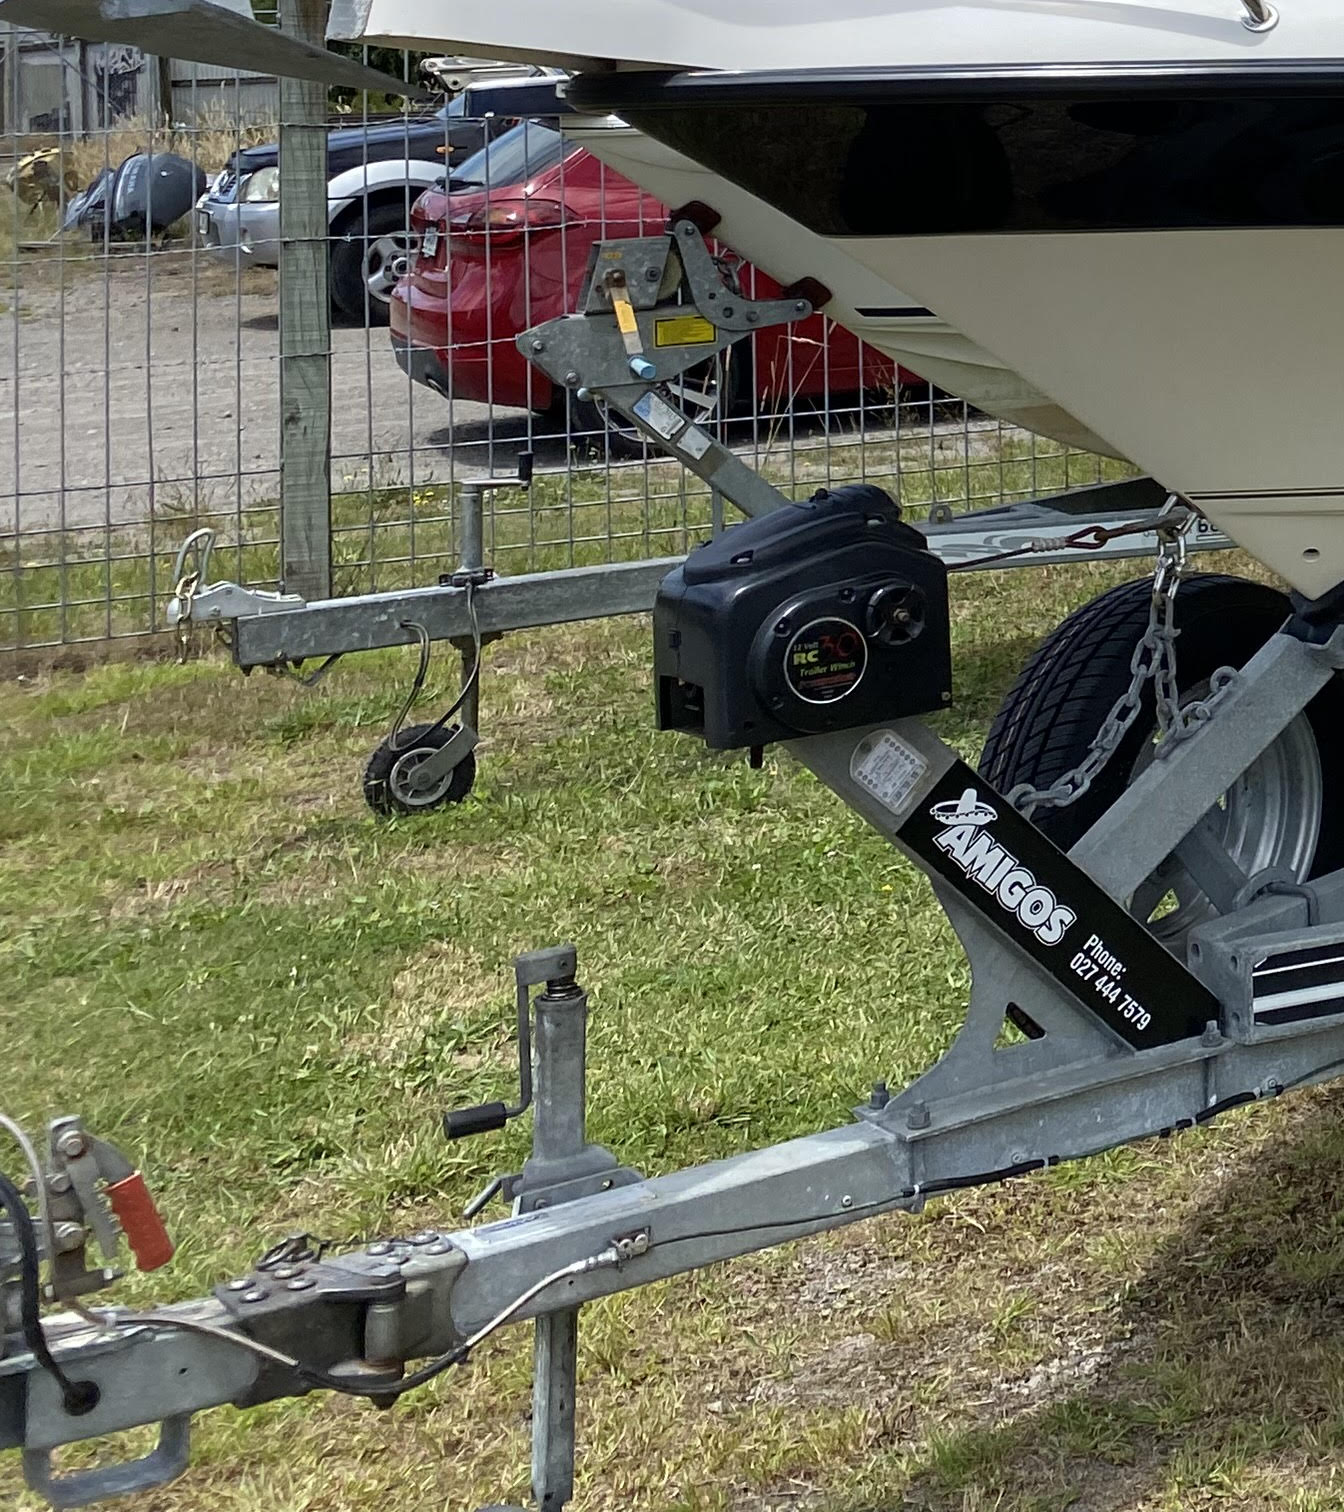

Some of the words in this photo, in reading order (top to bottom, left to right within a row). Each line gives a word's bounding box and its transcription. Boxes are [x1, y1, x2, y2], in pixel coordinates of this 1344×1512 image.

[793, 650, 819, 665] RC
[800, 667, 828, 678] Trailer
[932, 824, 1077, 946] AMIGOS
[1083, 934, 1126, 980] Phone:
[1070, 952, 1099, 981] 027
[1095, 975, 1121, 1004] 444
[1117, 994, 1151, 1031] 7579
